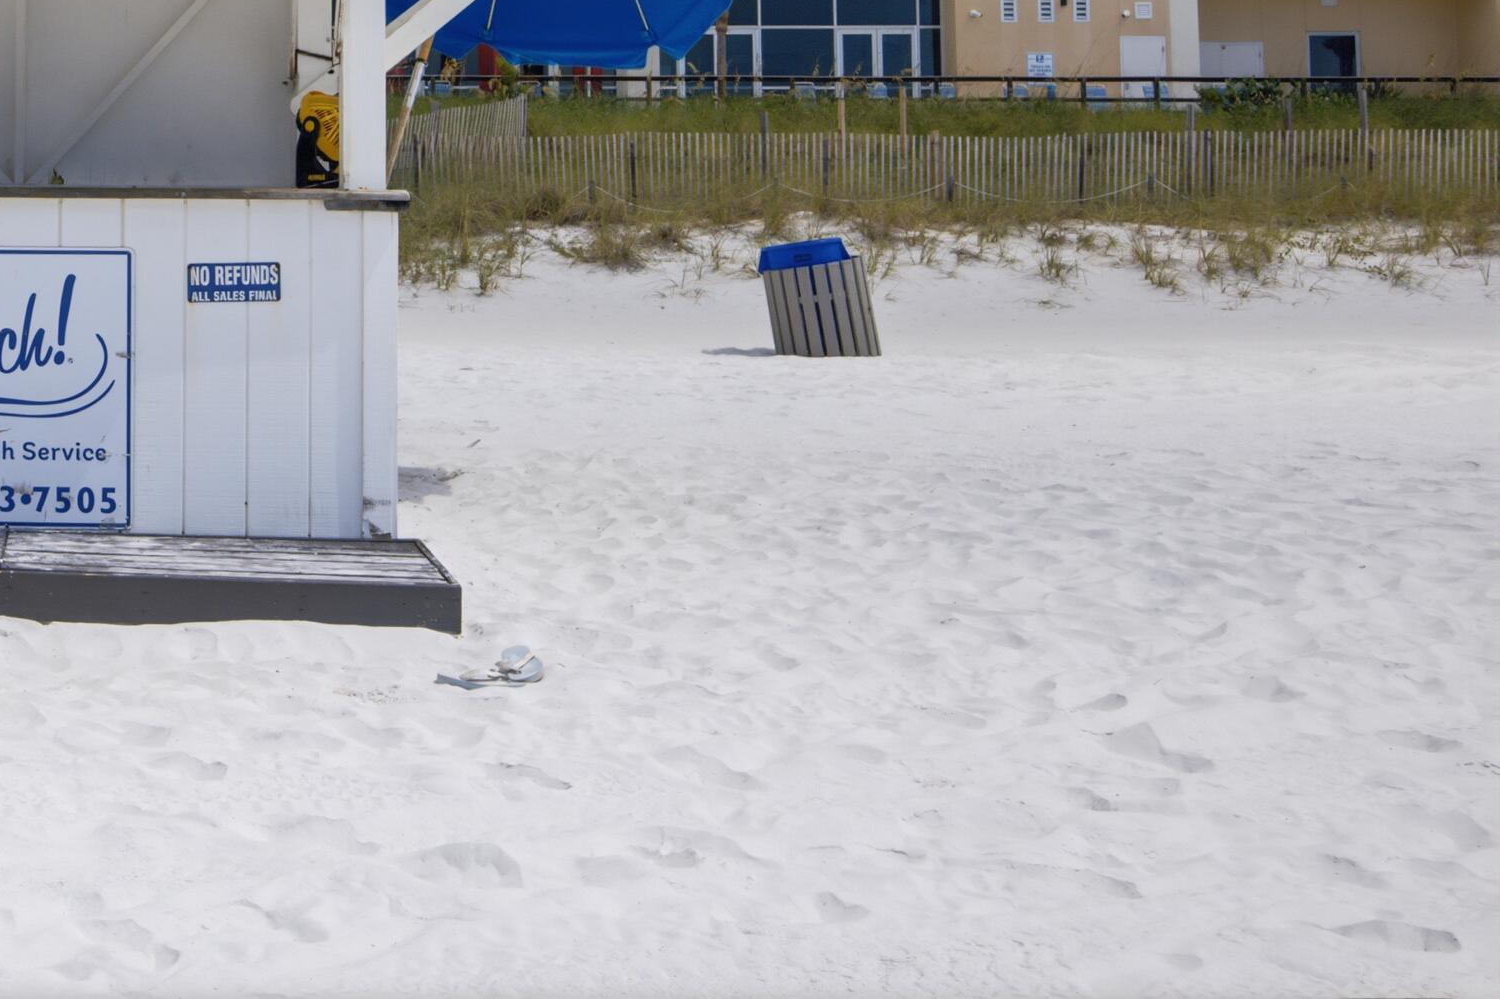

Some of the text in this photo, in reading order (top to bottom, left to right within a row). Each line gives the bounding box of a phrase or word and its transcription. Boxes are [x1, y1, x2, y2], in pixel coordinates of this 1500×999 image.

[190, 264, 278, 286] NO REFUNDS
[191, 290, 278, 302] ALL SALES FINAL
[22, 442, 108, 461] Service
